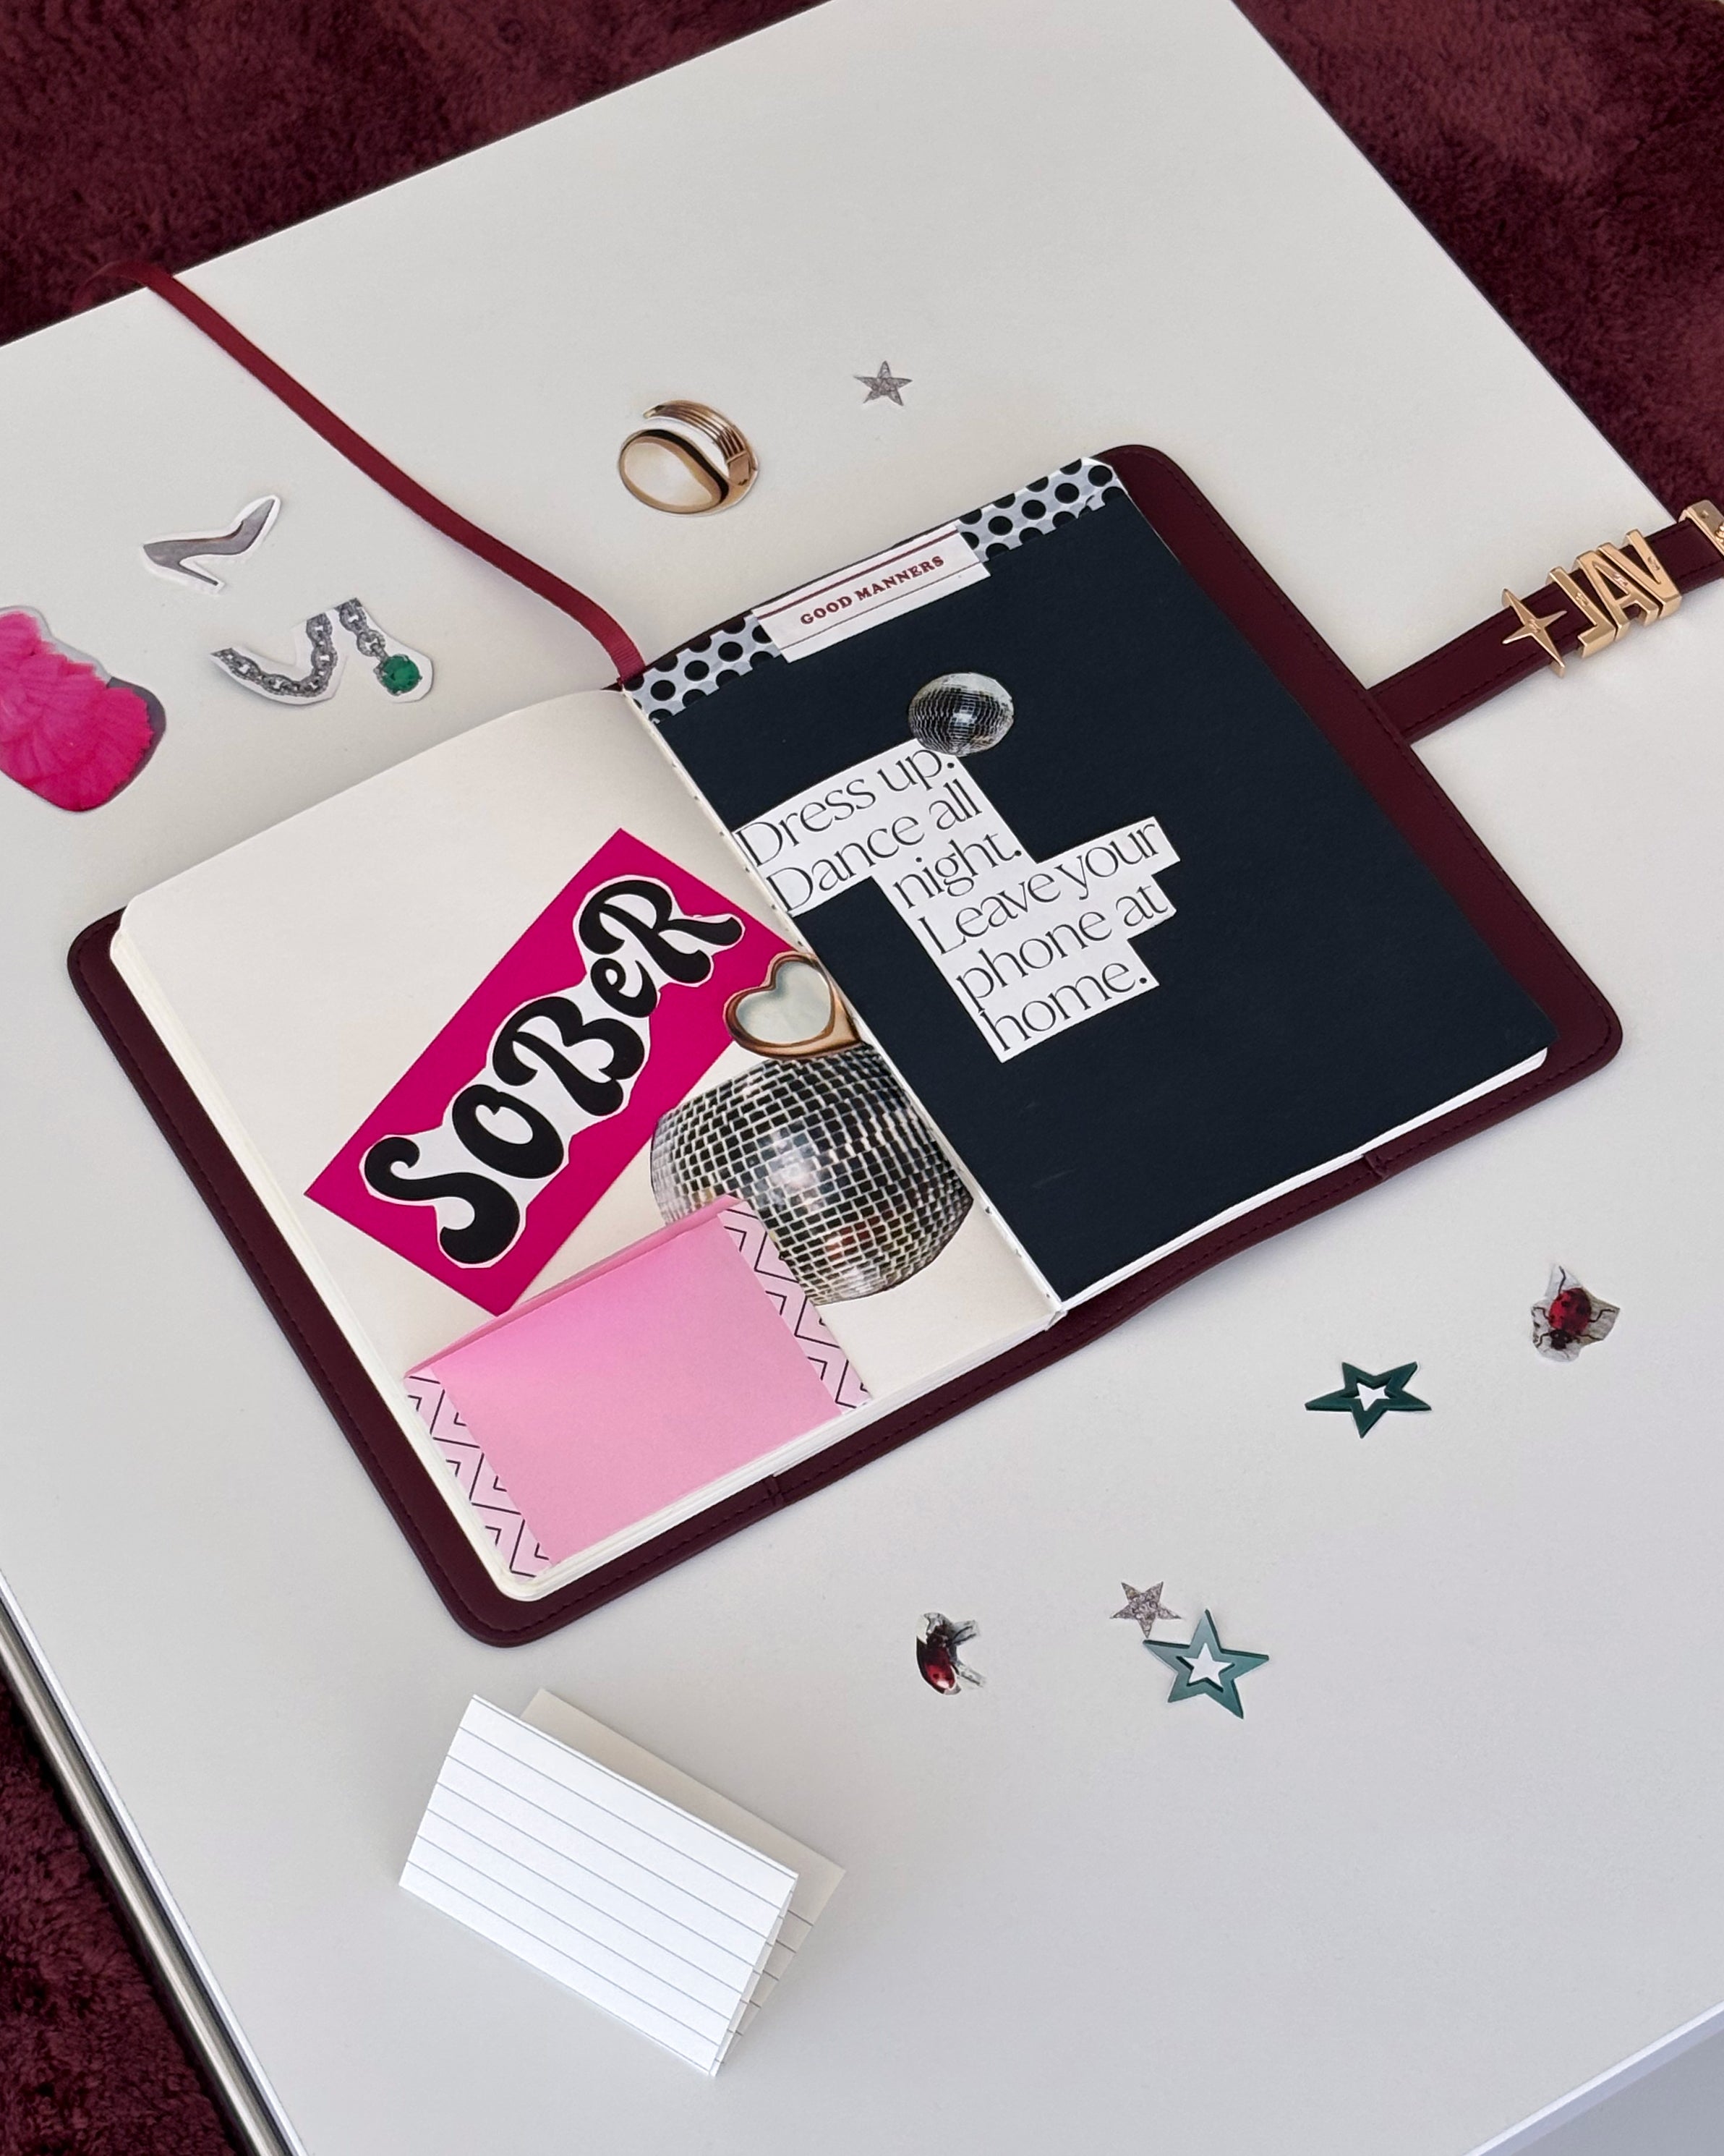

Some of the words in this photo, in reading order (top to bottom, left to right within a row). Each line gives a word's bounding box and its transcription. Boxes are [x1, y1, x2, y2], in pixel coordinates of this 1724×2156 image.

[801, 596, 853, 625] GOOD
[854, 555, 944, 600] MANNERS
[735, 778, 876, 866] Dress
[876, 749, 955, 791] up.
[766, 814, 926, 911] Dance
[928, 778, 983, 830] all
[892, 830, 1023, 908] night.
[918, 872, 1062, 954] Leave
[1054, 822, 1159, 900] your
[956, 909, 1113, 1012] phone
[1115, 884, 1169, 928] at
[980, 961, 1148, 1051] home.
